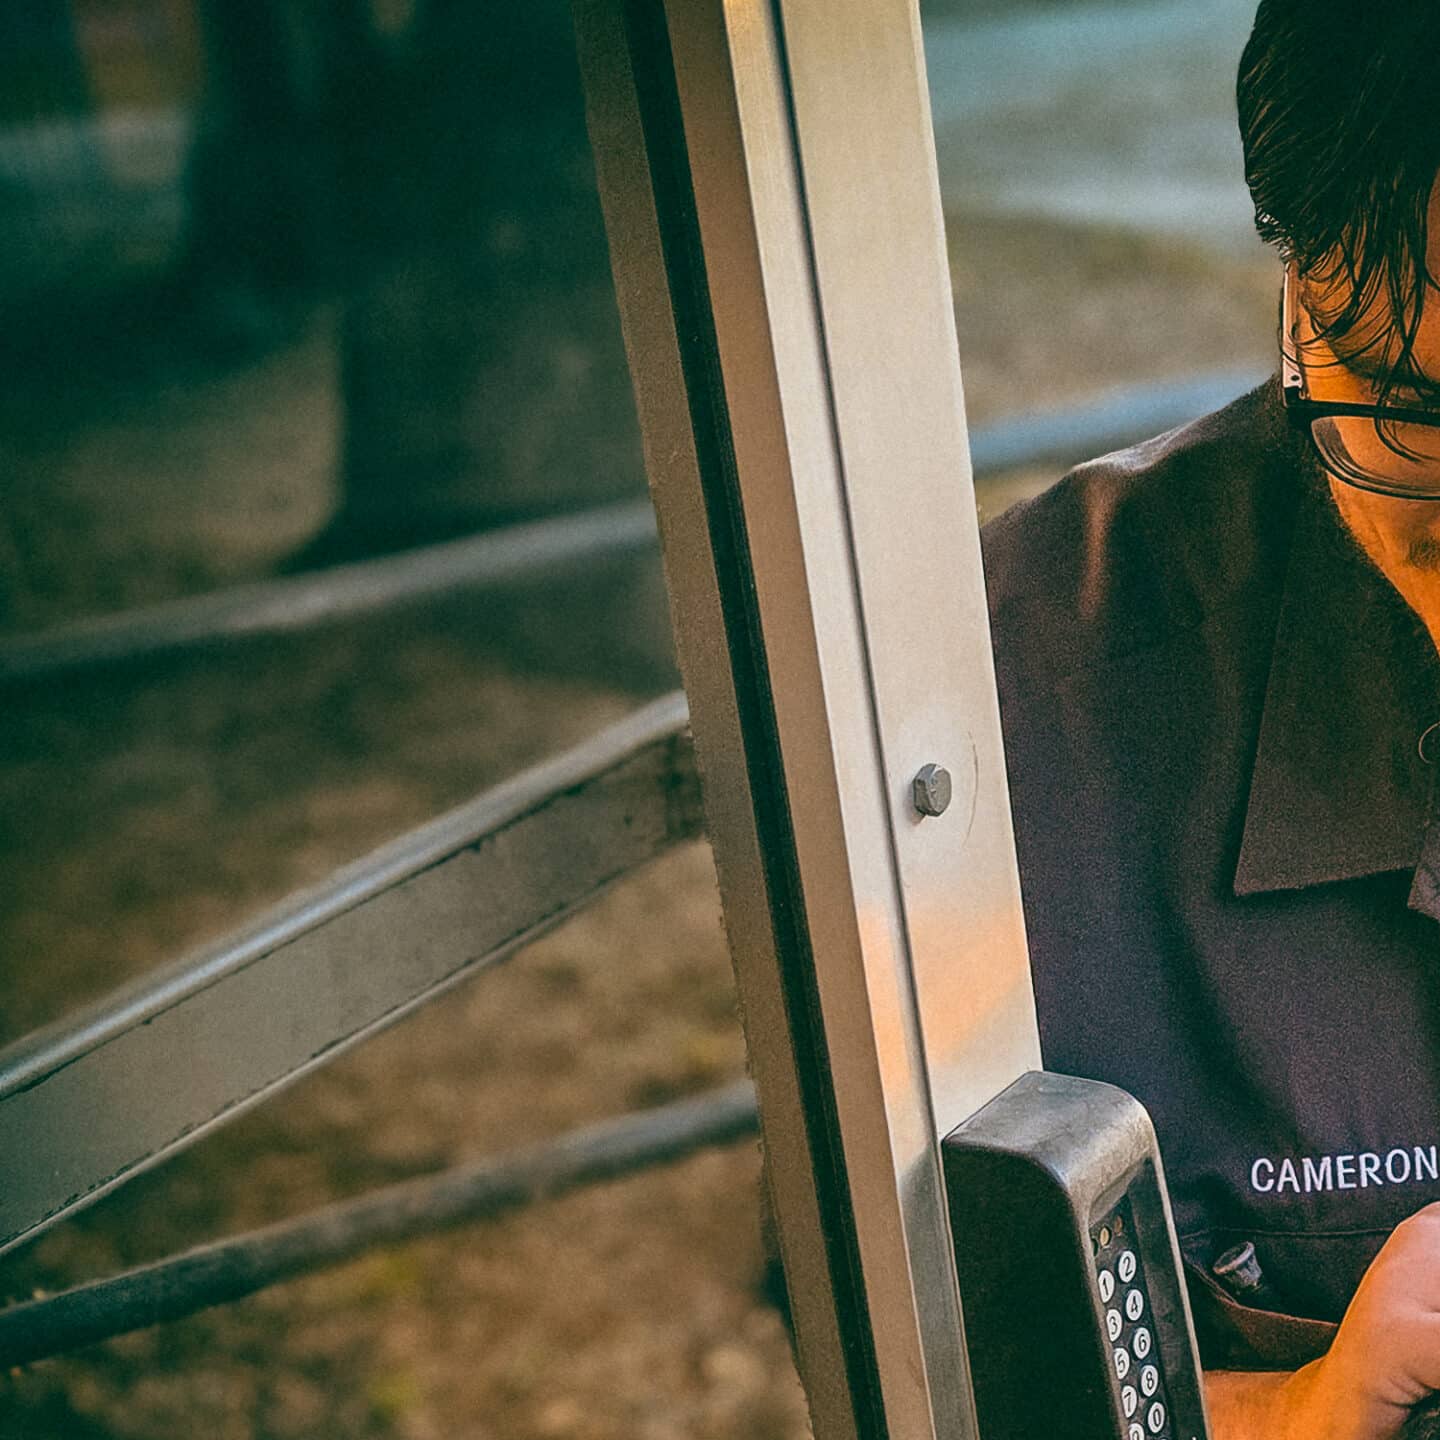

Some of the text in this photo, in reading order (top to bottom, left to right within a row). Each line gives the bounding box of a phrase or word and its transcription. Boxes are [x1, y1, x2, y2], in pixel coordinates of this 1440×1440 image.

[1251, 1146, 1439, 1193] CAMERON
[1123, 1256, 1133, 1277] 2
[1130, 1295, 1138, 1313] 4
[1109, 1315, 1118, 1335] 3
[1138, 1333, 1147, 1352] 6
[1117, 1352, 1126, 1373] 5
[1145, 1370, 1154, 1391] 8
[1123, 1391, 1132, 1412] 7
[1152, 1408, 1161, 1427] 0
